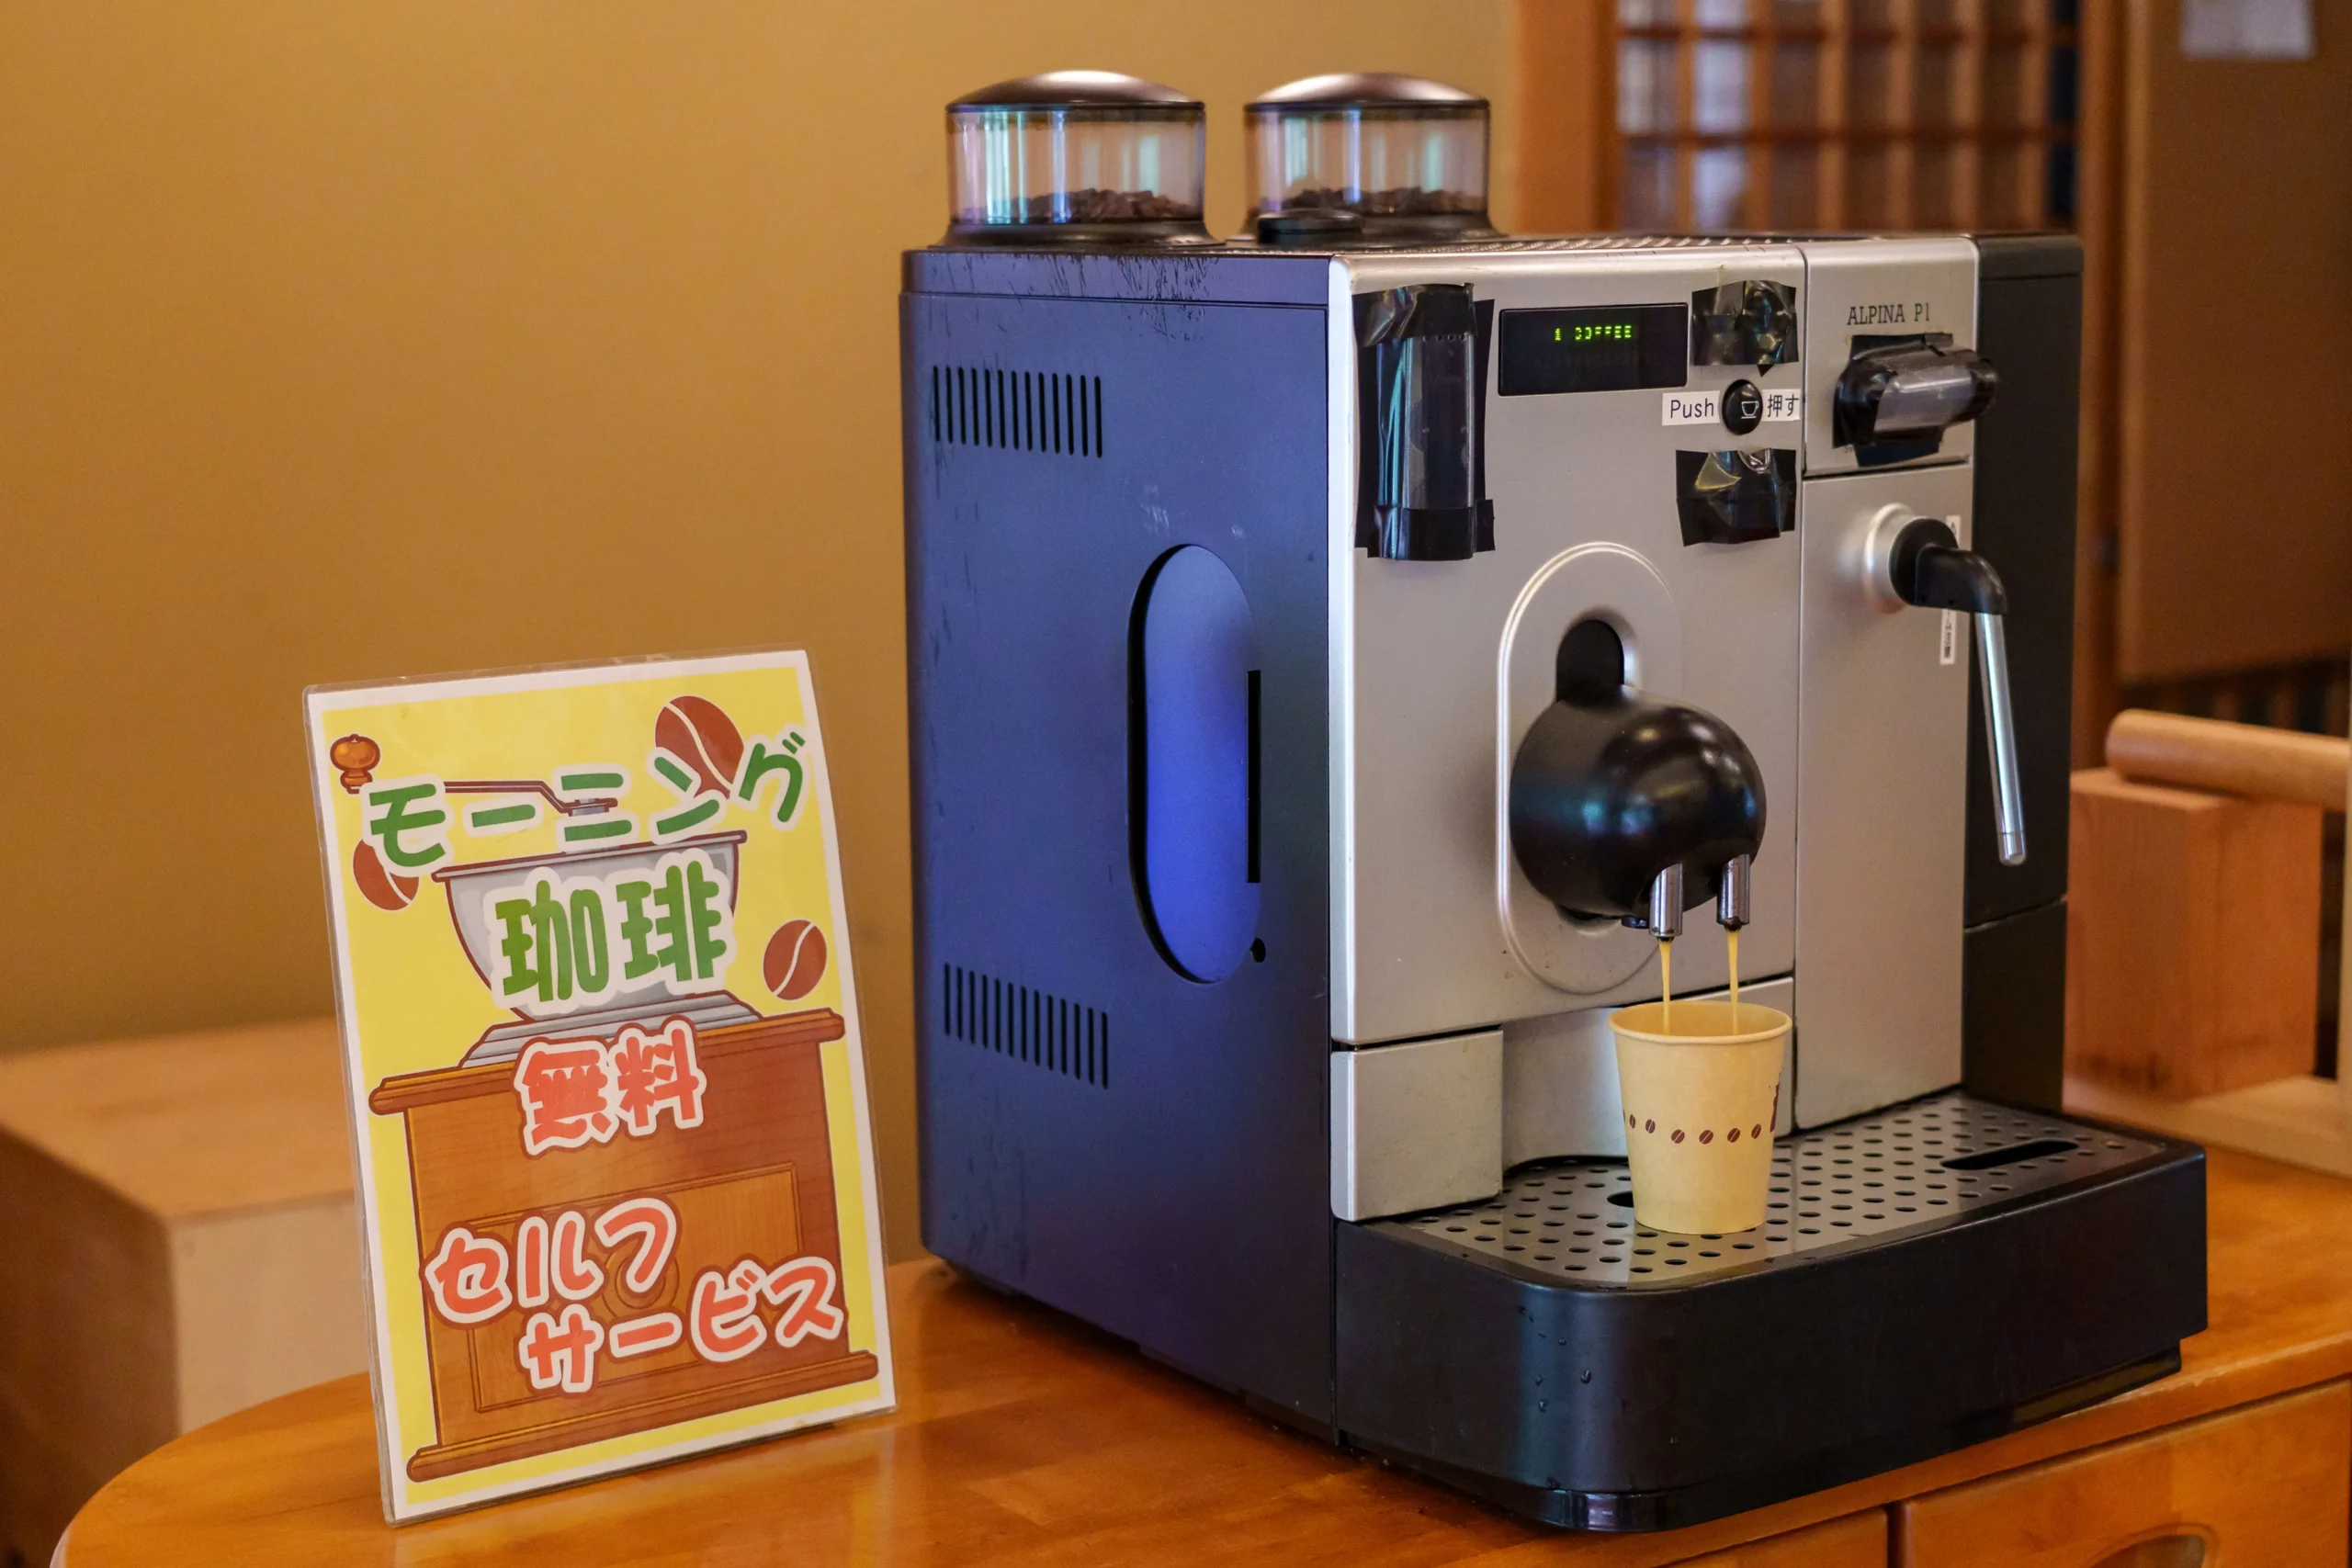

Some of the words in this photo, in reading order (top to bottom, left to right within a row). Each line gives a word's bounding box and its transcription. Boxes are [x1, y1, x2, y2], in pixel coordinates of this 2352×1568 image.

[1847, 304, 1905, 325] ALPINA
[1670, 398, 1714, 418] Push
[1768, 394, 1799, 417] 押す
[368, 731, 807, 868] モーニング
[494, 860, 727, 1002] 珈琲
[521, 1026, 701, 1147] 無料
[434, 1205, 670, 1314] セルフ
[526, 1265, 839, 1384] サービス
